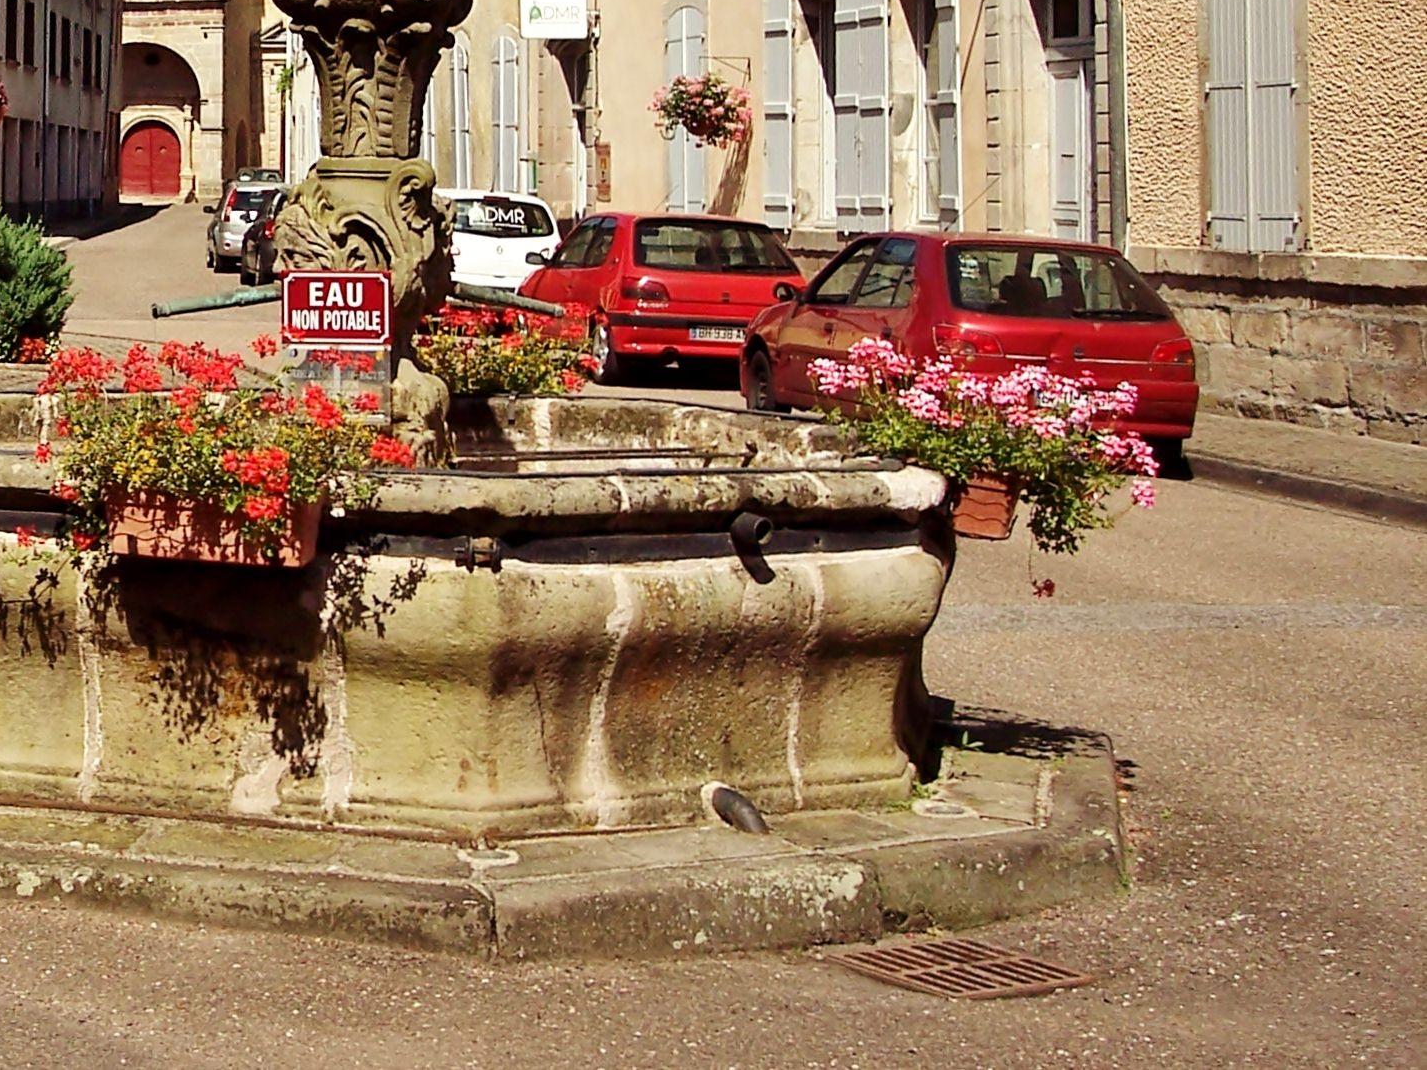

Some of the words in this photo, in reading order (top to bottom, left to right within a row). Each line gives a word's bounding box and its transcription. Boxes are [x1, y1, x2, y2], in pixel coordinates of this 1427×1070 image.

[529, 1, 580, 24] ADMR
[468, 202, 525, 226] ADMR
[309, 282, 363, 307] EAU
[292, 310, 319, 330] NON
[323, 310, 381, 331] POTABLE
